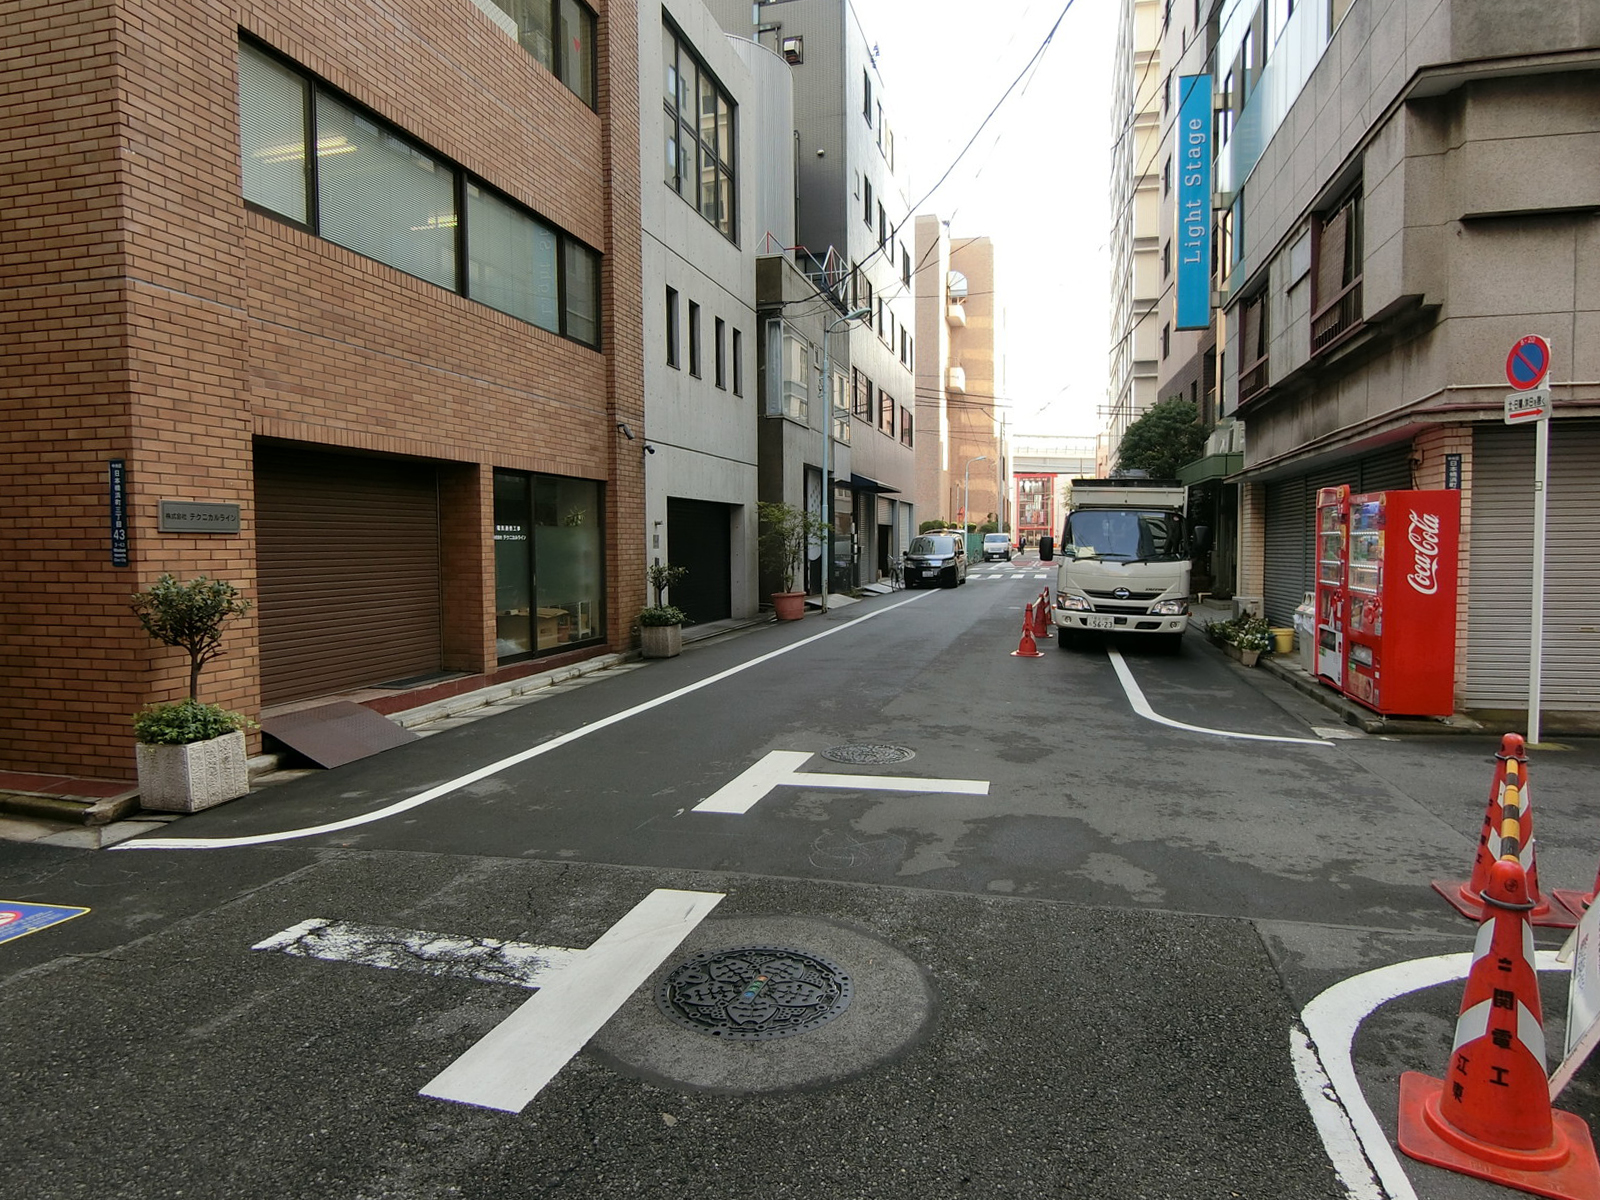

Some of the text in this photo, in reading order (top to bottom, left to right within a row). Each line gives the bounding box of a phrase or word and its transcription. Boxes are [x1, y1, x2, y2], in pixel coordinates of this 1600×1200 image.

[1184, 118, 1206, 264] Light Stage
[114, 470, 122, 528] 日本橋浜町三丁目
[165, 512, 237, 522] 株式会社 テクニカルライン
[113, 529, 126, 540] 43
